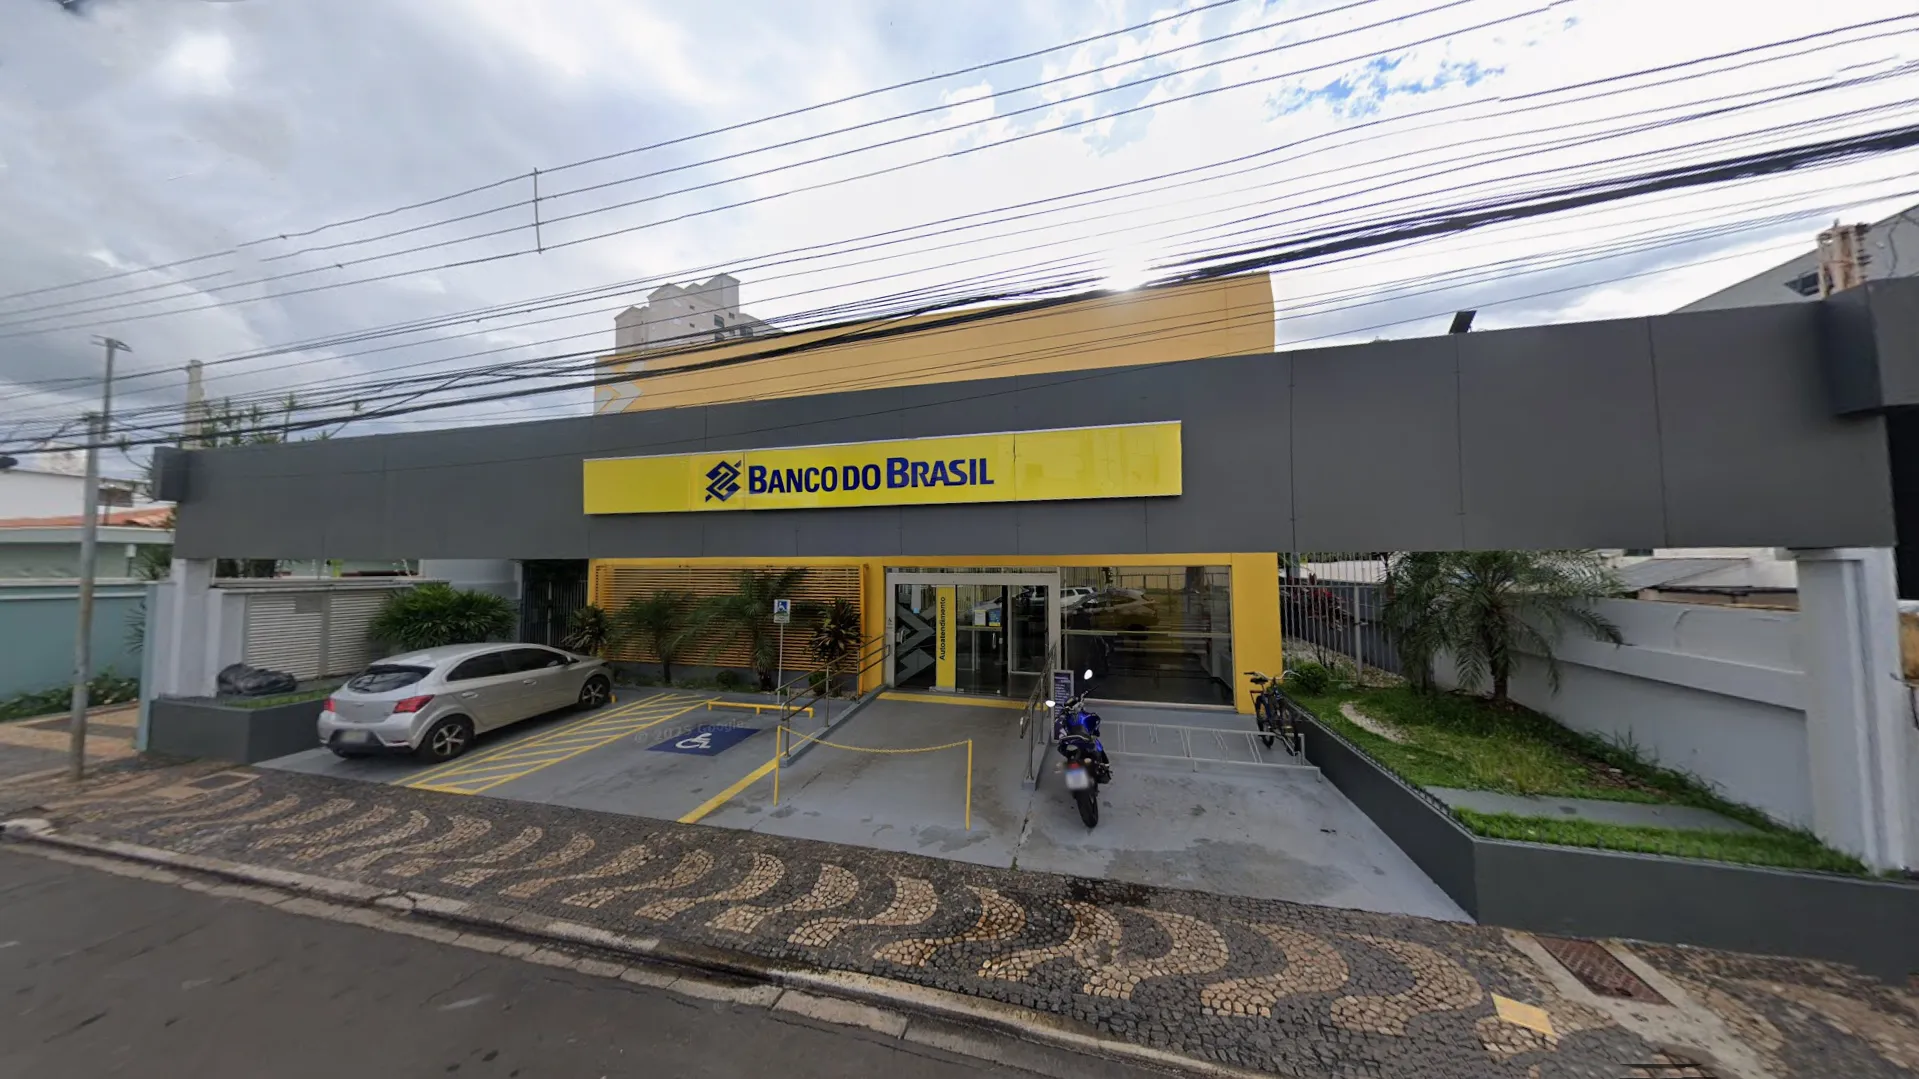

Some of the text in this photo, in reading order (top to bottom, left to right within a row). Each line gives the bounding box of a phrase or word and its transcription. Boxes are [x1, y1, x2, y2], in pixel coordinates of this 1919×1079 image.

[749, 457, 995, 494] BANCO DO BRASIL
